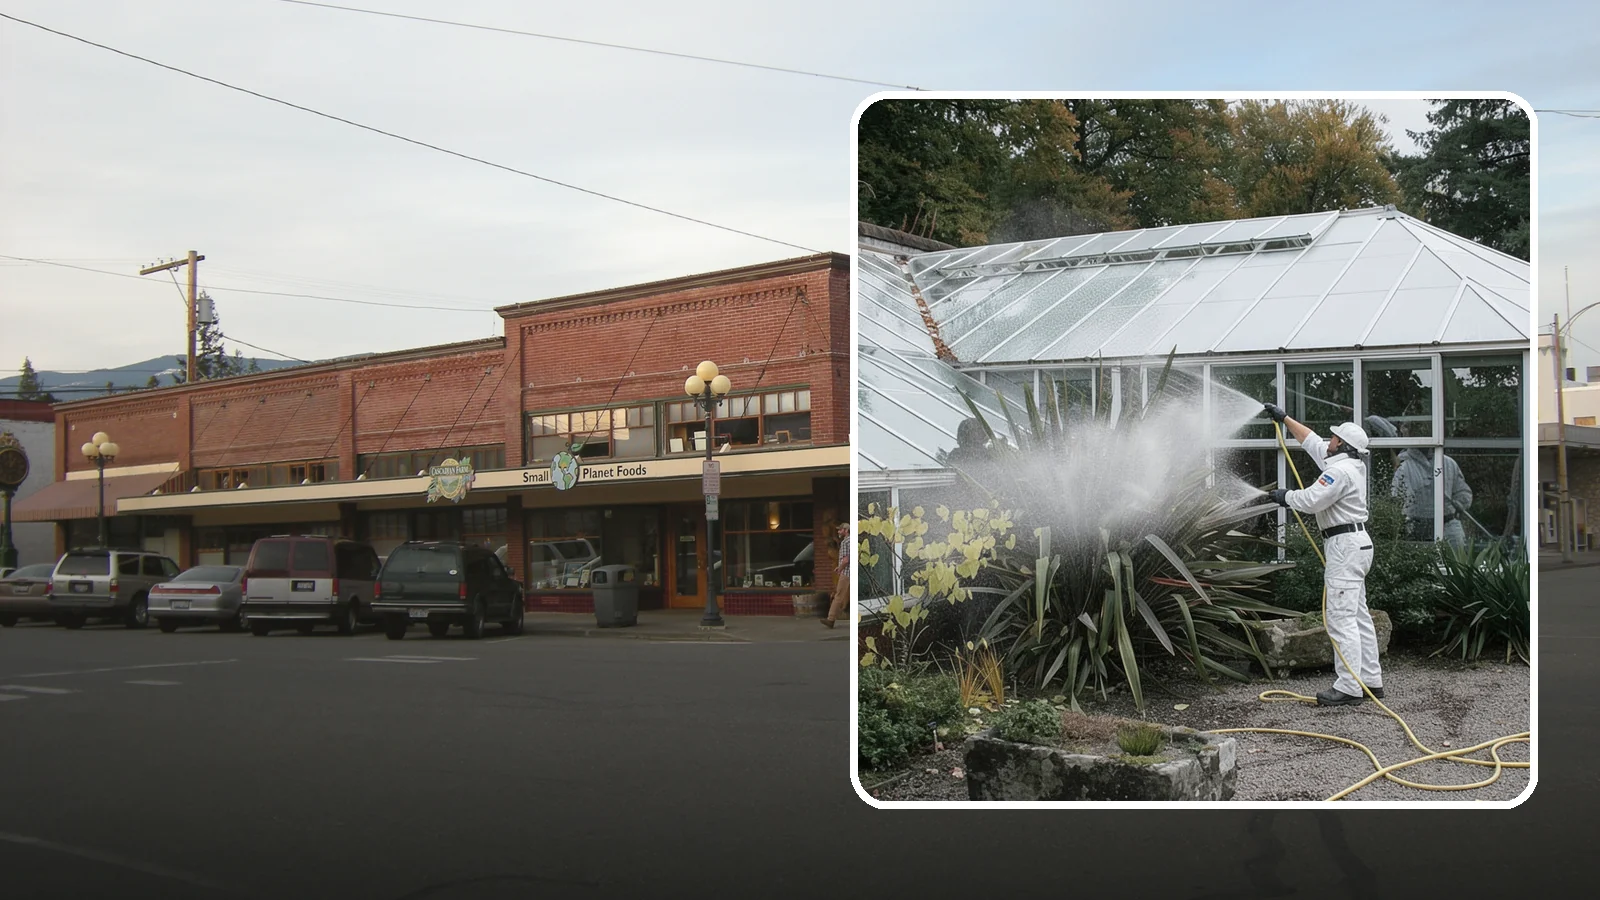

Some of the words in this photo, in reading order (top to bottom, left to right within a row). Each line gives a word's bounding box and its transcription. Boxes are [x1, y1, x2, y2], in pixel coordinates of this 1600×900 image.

[523, 471, 549, 482] Small
[583, 468, 614, 479] Planet
[617, 465, 647, 477] Foods
